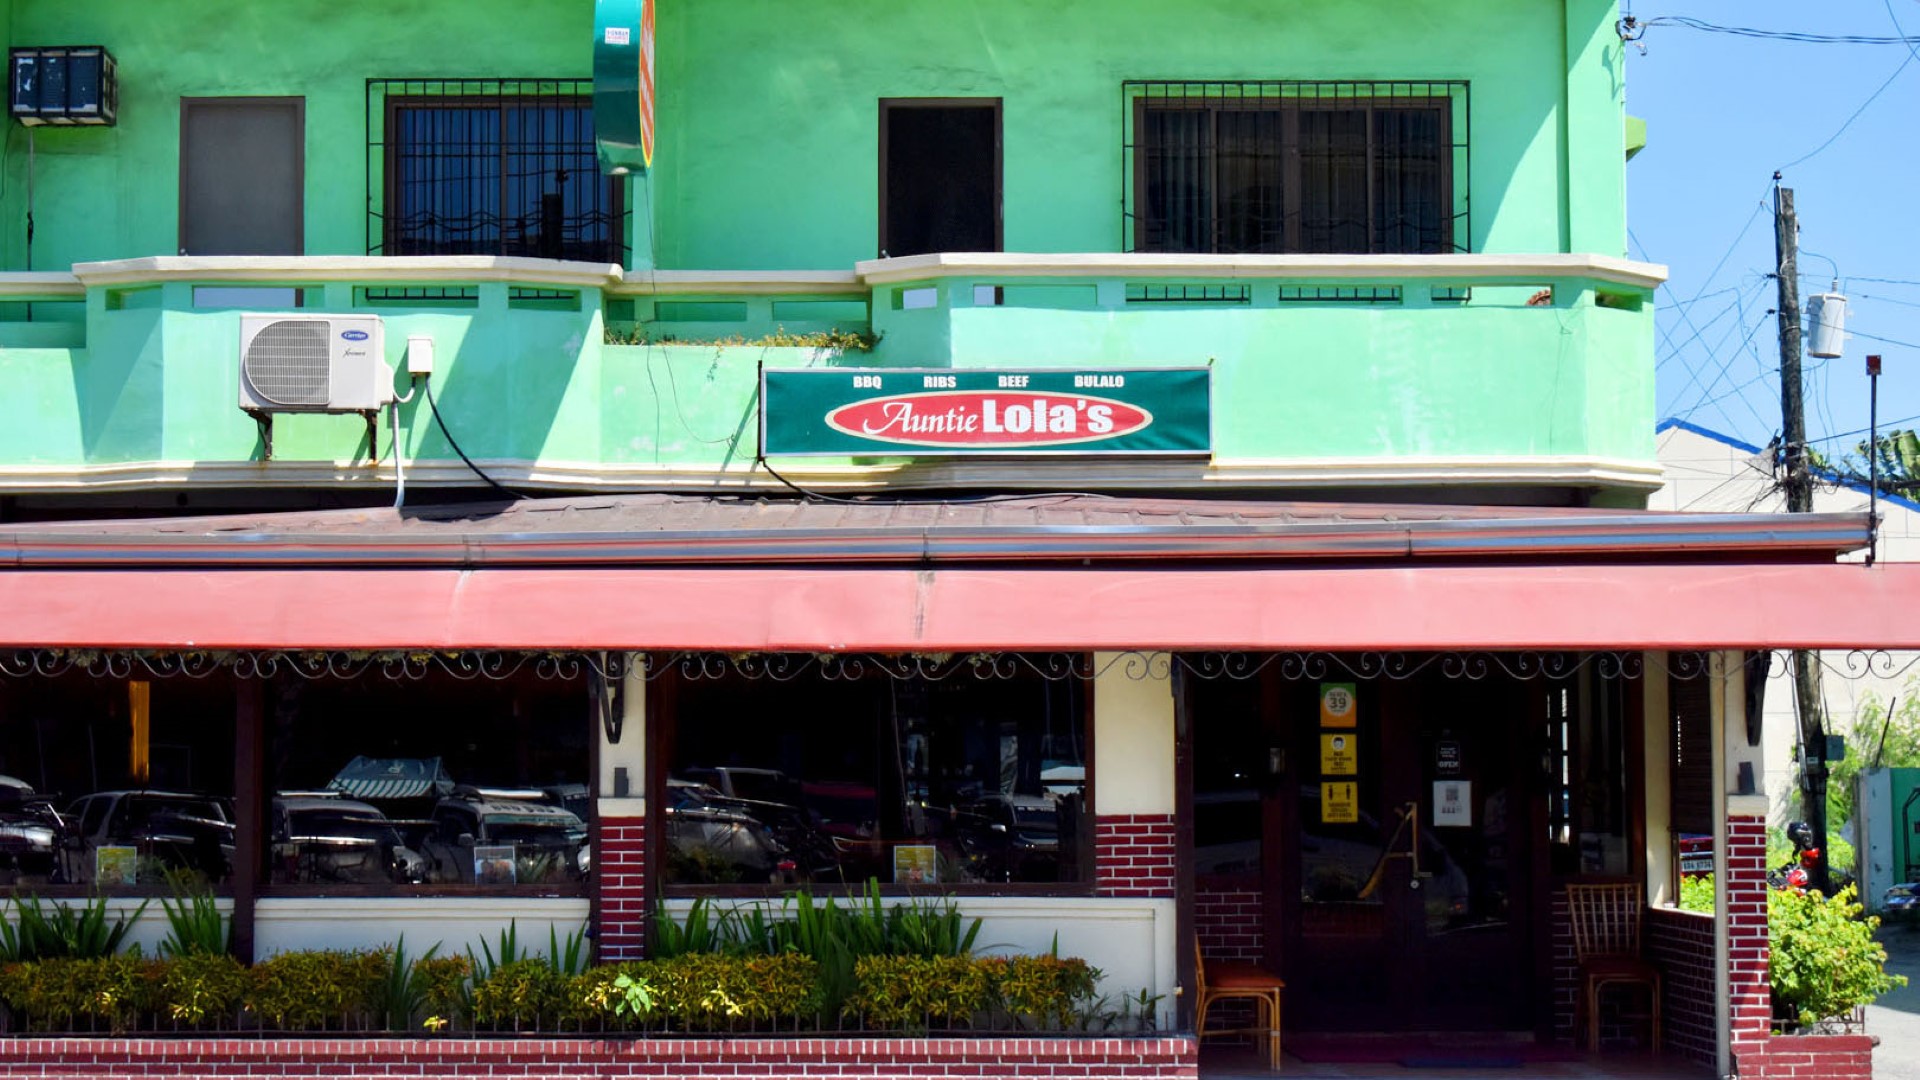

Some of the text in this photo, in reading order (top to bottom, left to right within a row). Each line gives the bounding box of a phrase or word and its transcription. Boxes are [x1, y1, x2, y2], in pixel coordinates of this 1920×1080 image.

[853, 375, 1125, 390] BBQ RIBS BEEF BULALO
[862, 399, 1115, 435] Auntie Lola's
